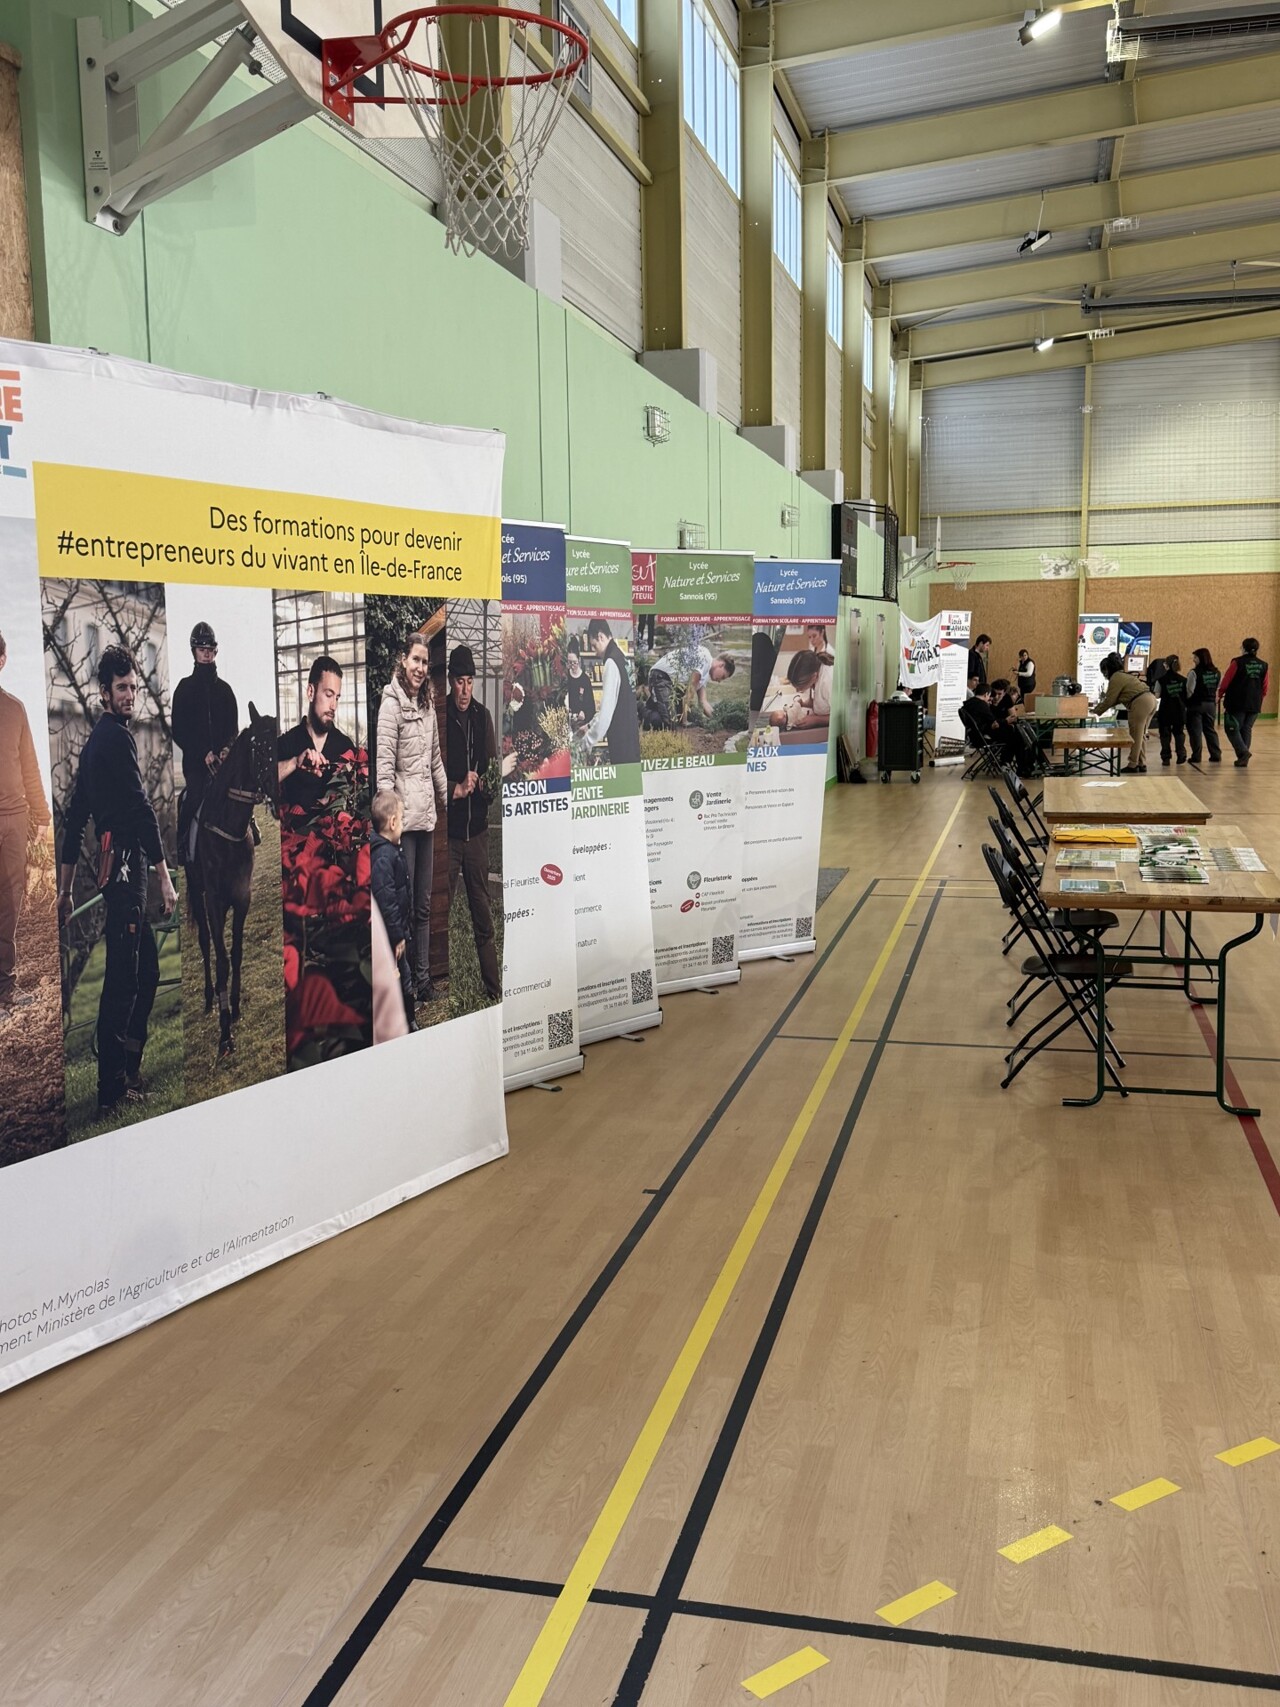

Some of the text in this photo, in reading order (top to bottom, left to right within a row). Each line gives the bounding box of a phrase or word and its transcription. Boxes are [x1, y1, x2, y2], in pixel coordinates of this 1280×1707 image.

[209, 506, 463, 558] Des formations pour devenir
[502, 534, 514, 544] cée
[58, 530, 463, 583] #entrepreneurs du vivant en Île-de-France
[502, 546, 550, 564] et Services
[572, 548, 590, 560] Lycée
[580, 566, 588, 576] et
[588, 561, 620, 576] Services
[688, 562, 709, 570] Lycée
[780, 568, 798, 577] Lycée
[502, 574, 528, 584] ois (95)
[662, 571, 740, 589] Nature et Services
[566, 583, 602, 594] Sannois (95)
[754, 578, 828, 594] Nature et Services
[680, 593, 718, 601] Sannois (95)
[794, 598, 806, 606] (95)
[526, 604, 566, 613] APPRENTISSAGE
[756, 746, 779, 757] AUX
[671, 757, 684, 769] LE
[686, 755, 715, 767] BEAU
[747, 761, 767, 772] NES
[502, 780, 547, 798] ASSION
[515, 798, 568, 816] ARTISTES
[571, 802, 630, 820] JARDINERIE
[572, 843, 608, 855] éveloppées
[510, 876, 540, 888] Fleuriste
[503, 908, 530, 923] oppées
[574, 904, 602, 915] ommerce
[578, 938, 598, 948] nature
[504, 978, 552, 998] et commercial
[36, 1304, 96, 1339] Ministère
[99, 1294, 116, 1310] de
[118, 1262, 188, 1302] l'Agriculture
[190, 1255, 202, 1268] et
[204, 1247, 220, 1263] de
[222, 1214, 295, 1255] l'Alimentation
[0, 1276, 110, 1332] hotos M.Mynolas
